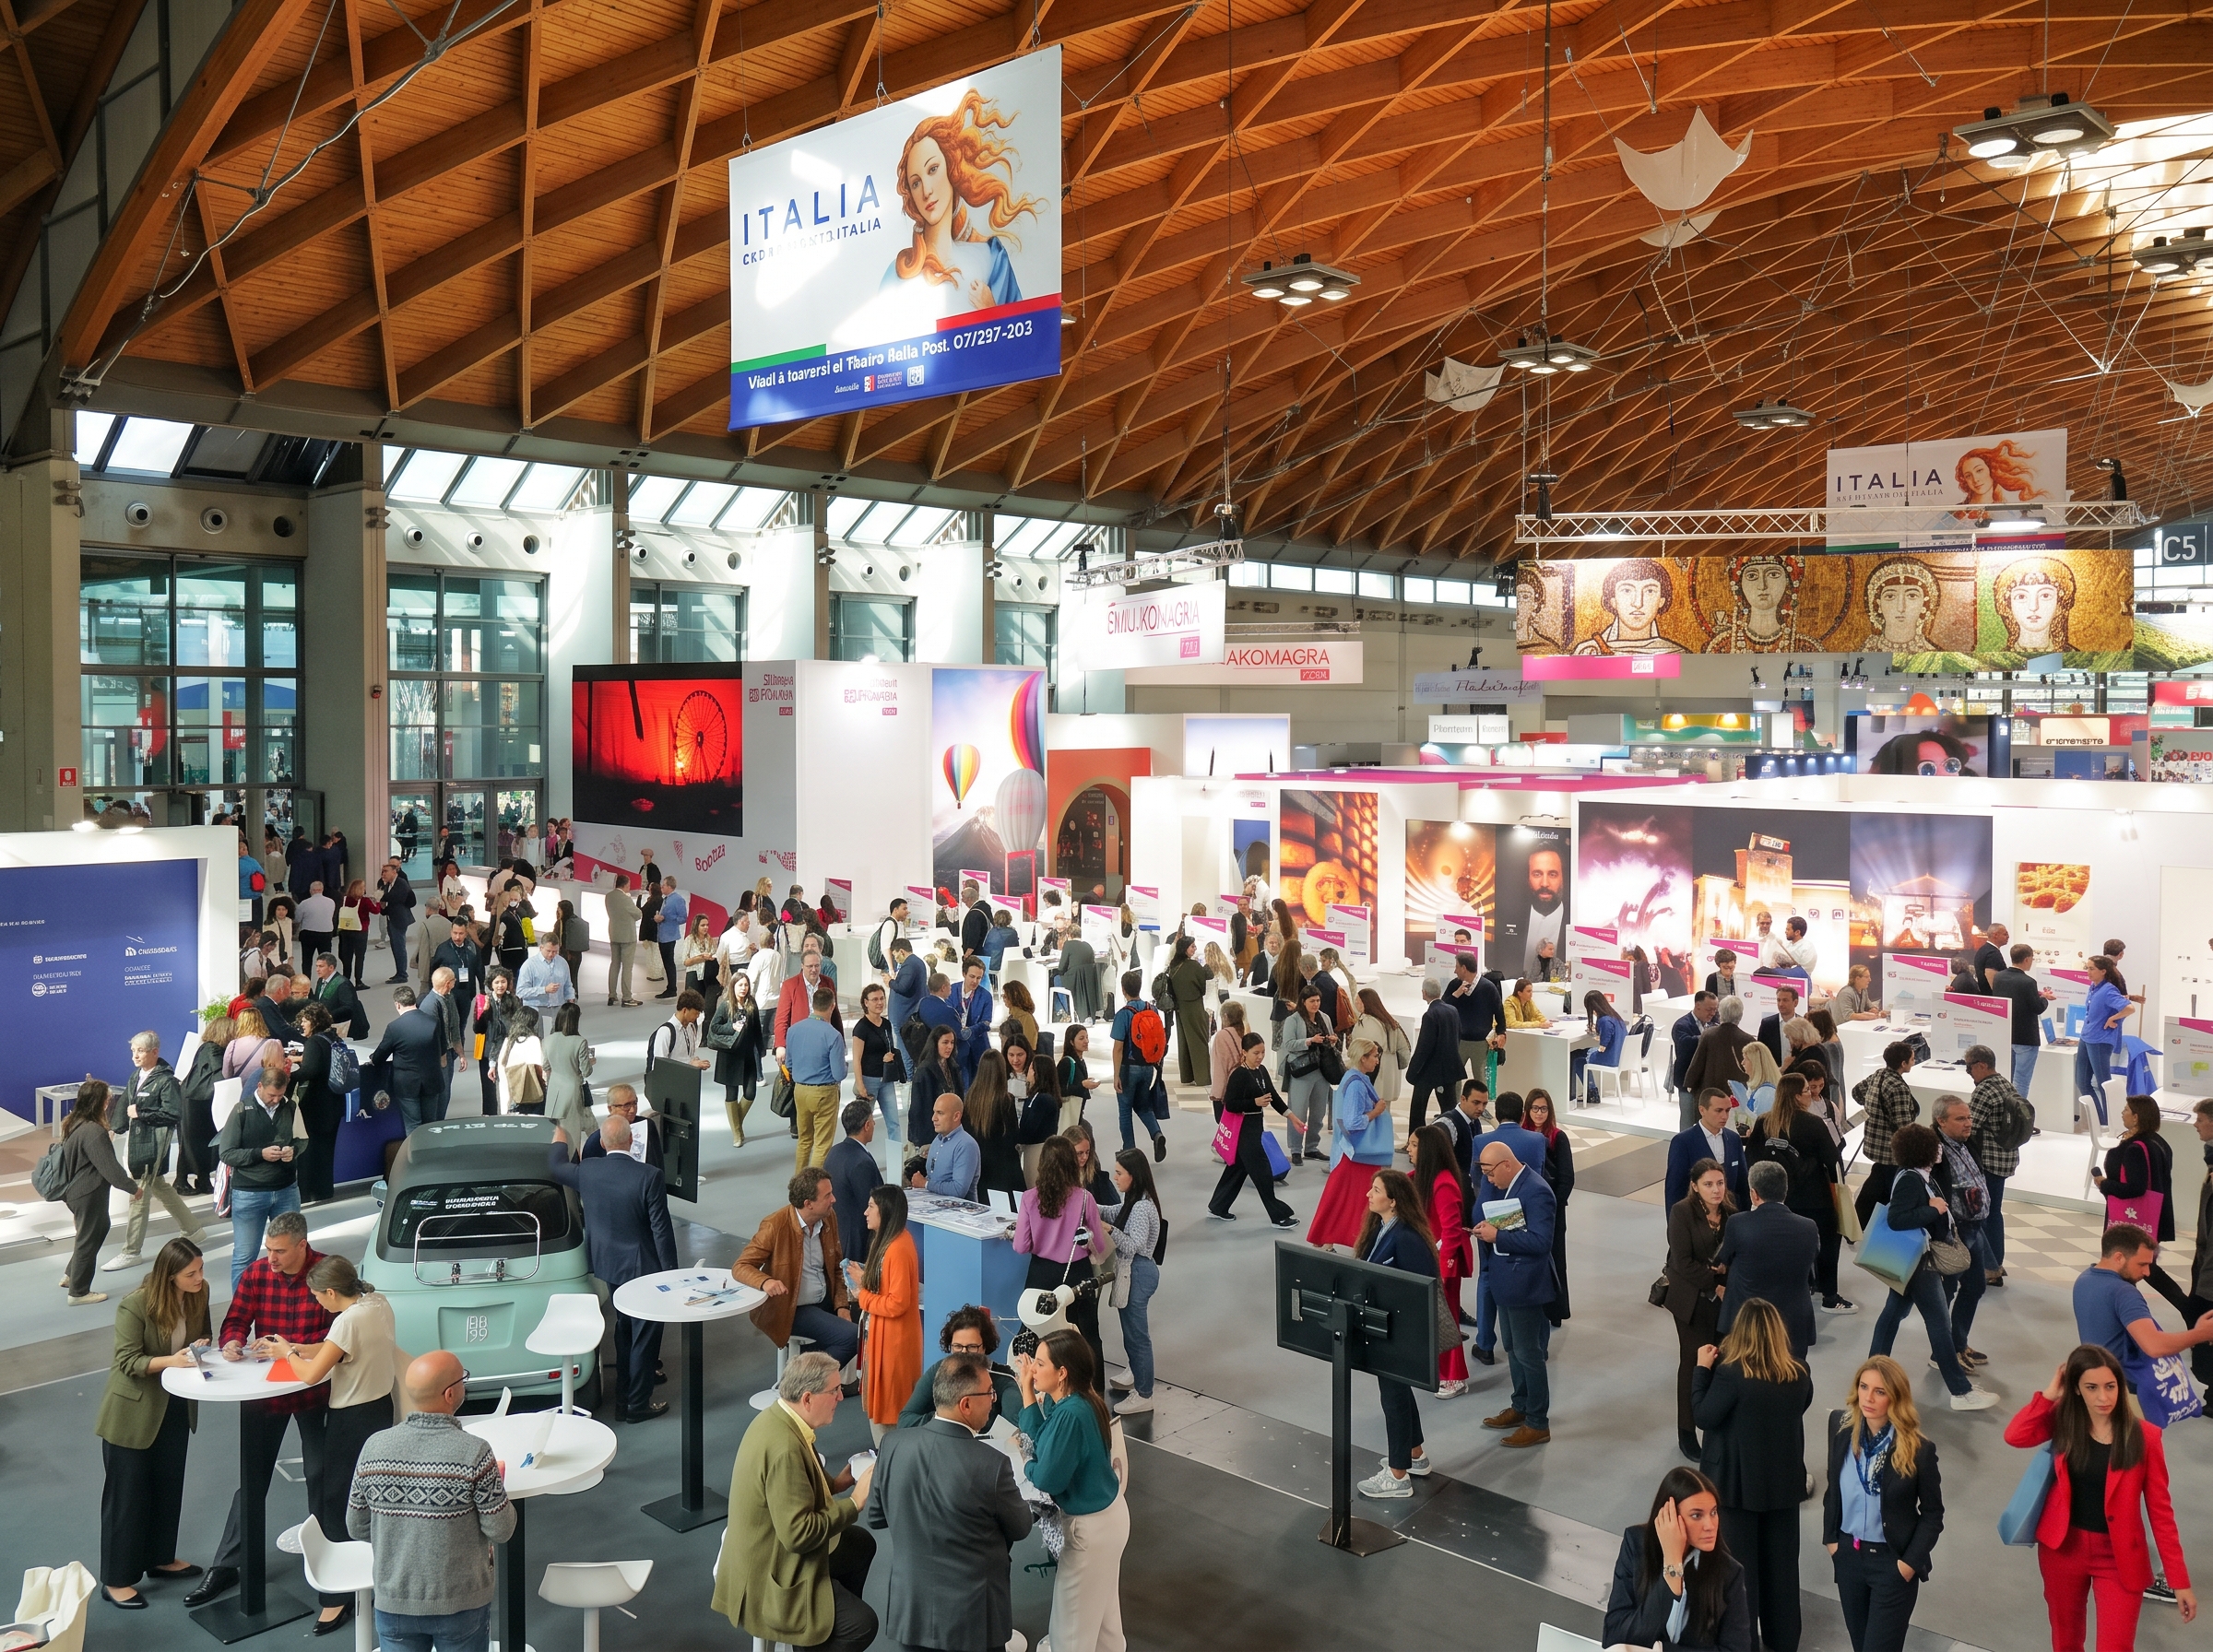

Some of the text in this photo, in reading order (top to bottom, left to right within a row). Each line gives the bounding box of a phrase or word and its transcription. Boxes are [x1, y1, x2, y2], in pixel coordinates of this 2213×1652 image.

[743, 174, 880, 246] ITALIA
[833, 358, 843, 373] el
[922, 338, 950, 357] Post.
[1837, 468, 1943, 492] ITALIA
[2163, 535, 2196, 561] C5
[1215, 648, 1331, 666] AKOMAGRA
